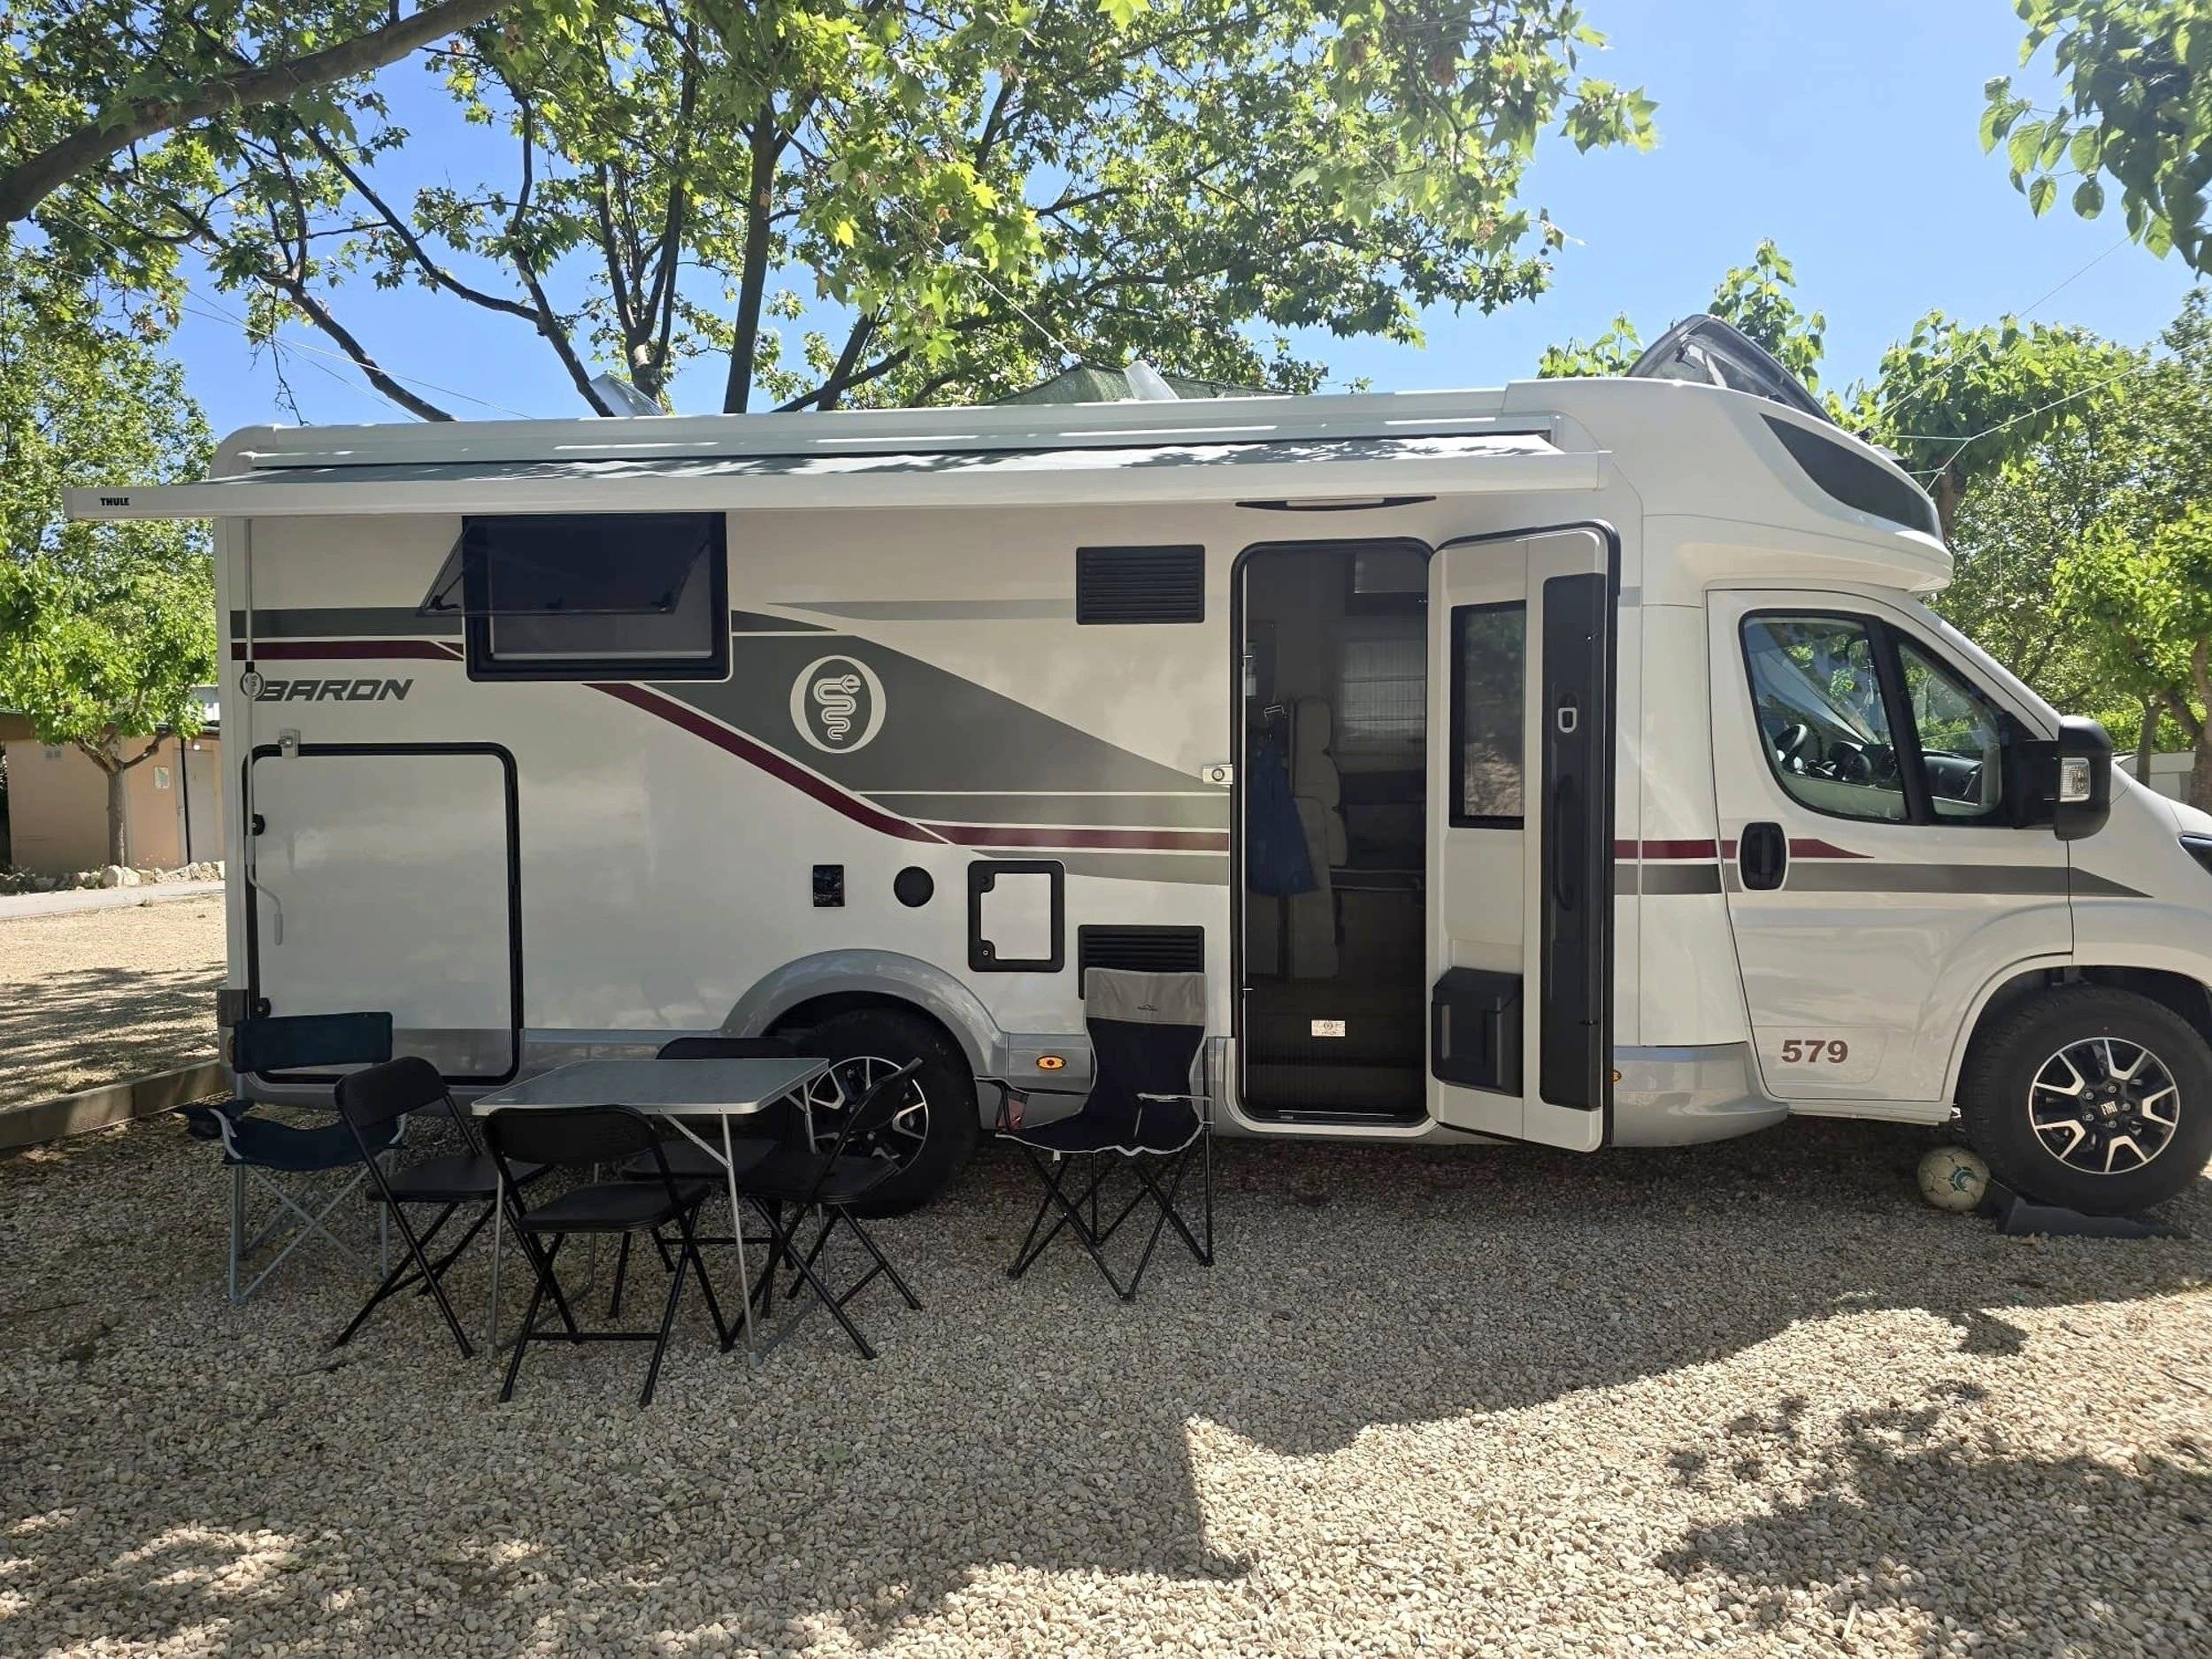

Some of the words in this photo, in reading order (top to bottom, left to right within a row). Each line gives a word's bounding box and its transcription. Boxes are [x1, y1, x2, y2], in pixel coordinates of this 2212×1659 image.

[100, 497, 130, 506] THULE
[254, 679, 414, 702] BARON
[1781, 1040, 1848, 1064] 579
